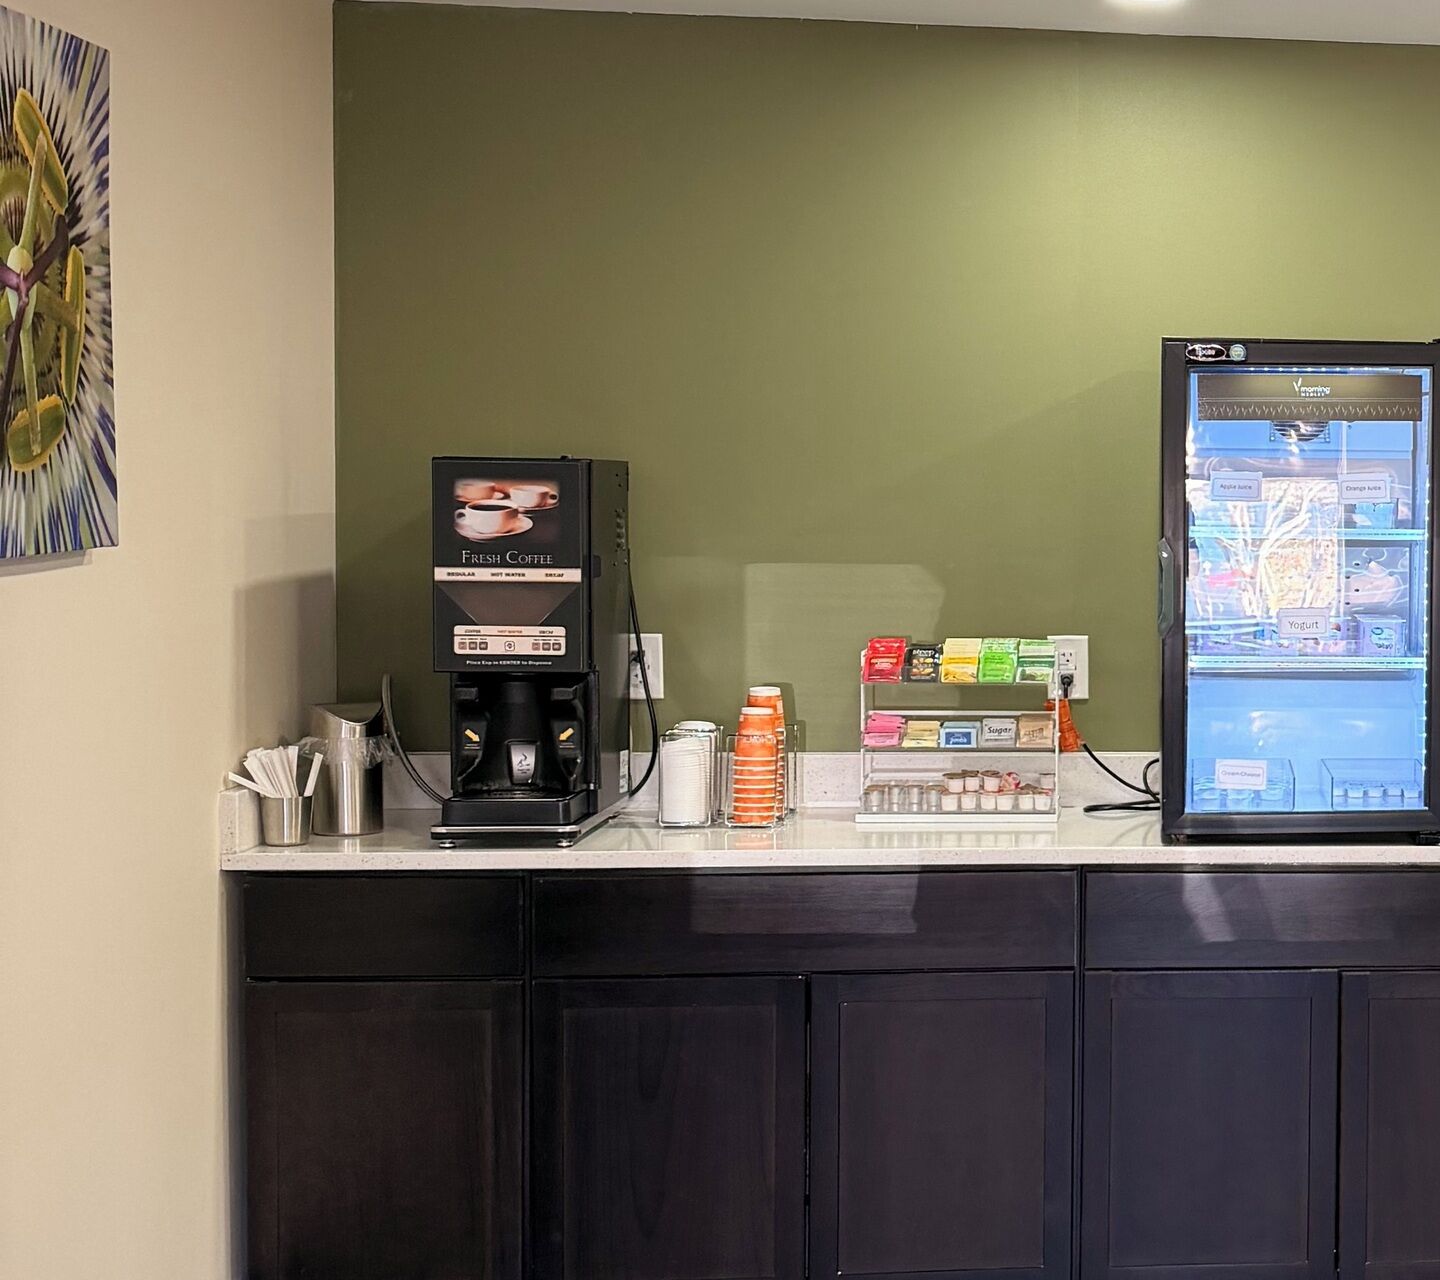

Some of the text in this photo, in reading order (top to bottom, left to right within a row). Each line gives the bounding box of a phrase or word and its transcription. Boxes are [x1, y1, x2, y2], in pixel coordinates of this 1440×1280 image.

[1301, 386, 1331, 394] morning
[462, 550, 554, 565] FRESH COFFEE
[1288, 620, 1319, 631] Yogurt
[987, 726, 1012, 735] Sugar
